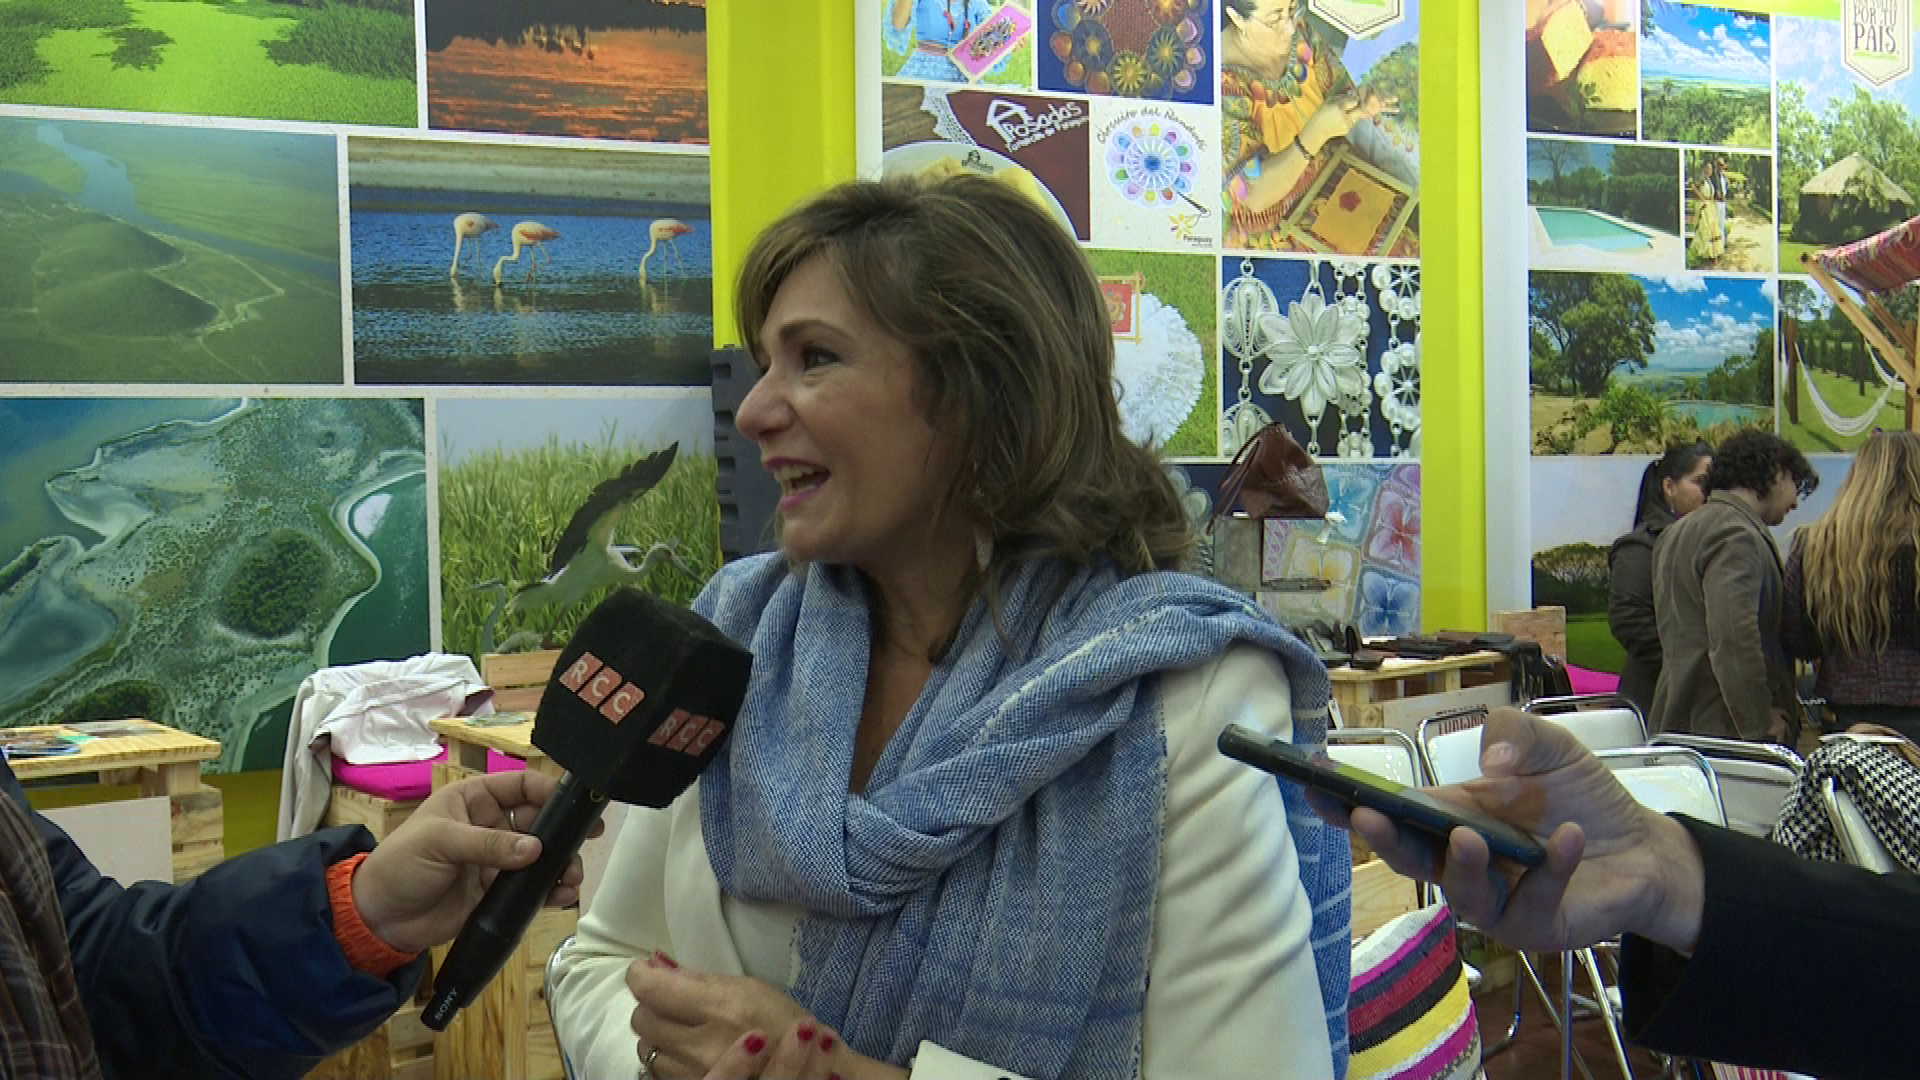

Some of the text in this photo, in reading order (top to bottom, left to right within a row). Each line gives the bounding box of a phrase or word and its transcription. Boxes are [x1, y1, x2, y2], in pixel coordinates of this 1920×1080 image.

[1853, 4, 1876, 25] POR
[1882, 8, 1898, 26] TU
[569, 660, 634, 717] RCC
[658, 716, 715, 750] RCC
[434, 987, 457, 1021] SONY
